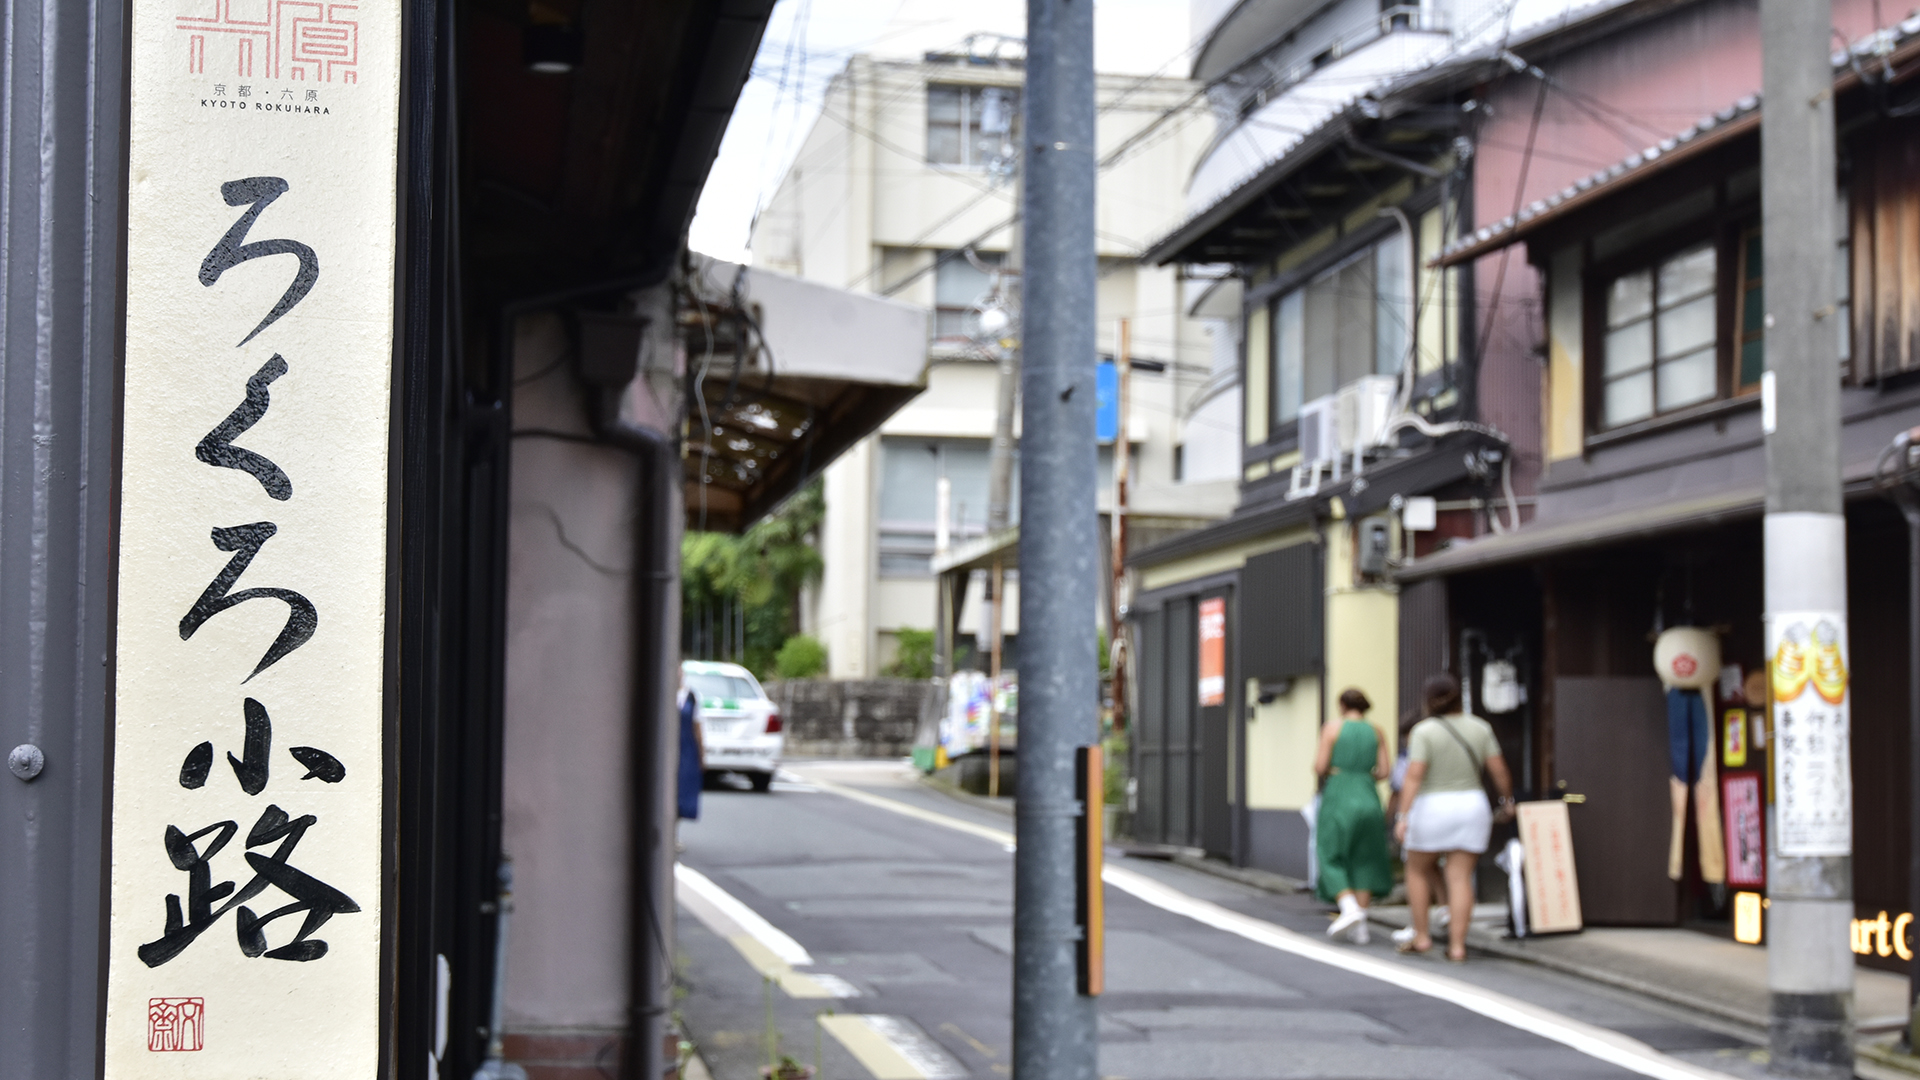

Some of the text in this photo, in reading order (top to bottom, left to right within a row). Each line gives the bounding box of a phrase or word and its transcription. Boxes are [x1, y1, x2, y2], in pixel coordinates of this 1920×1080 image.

[213, 83, 318, 102] 京都・六原
[201, 99, 330, 115] KYOTO ROKUHARA
[138, 176, 361, 968] ろくろ小路
